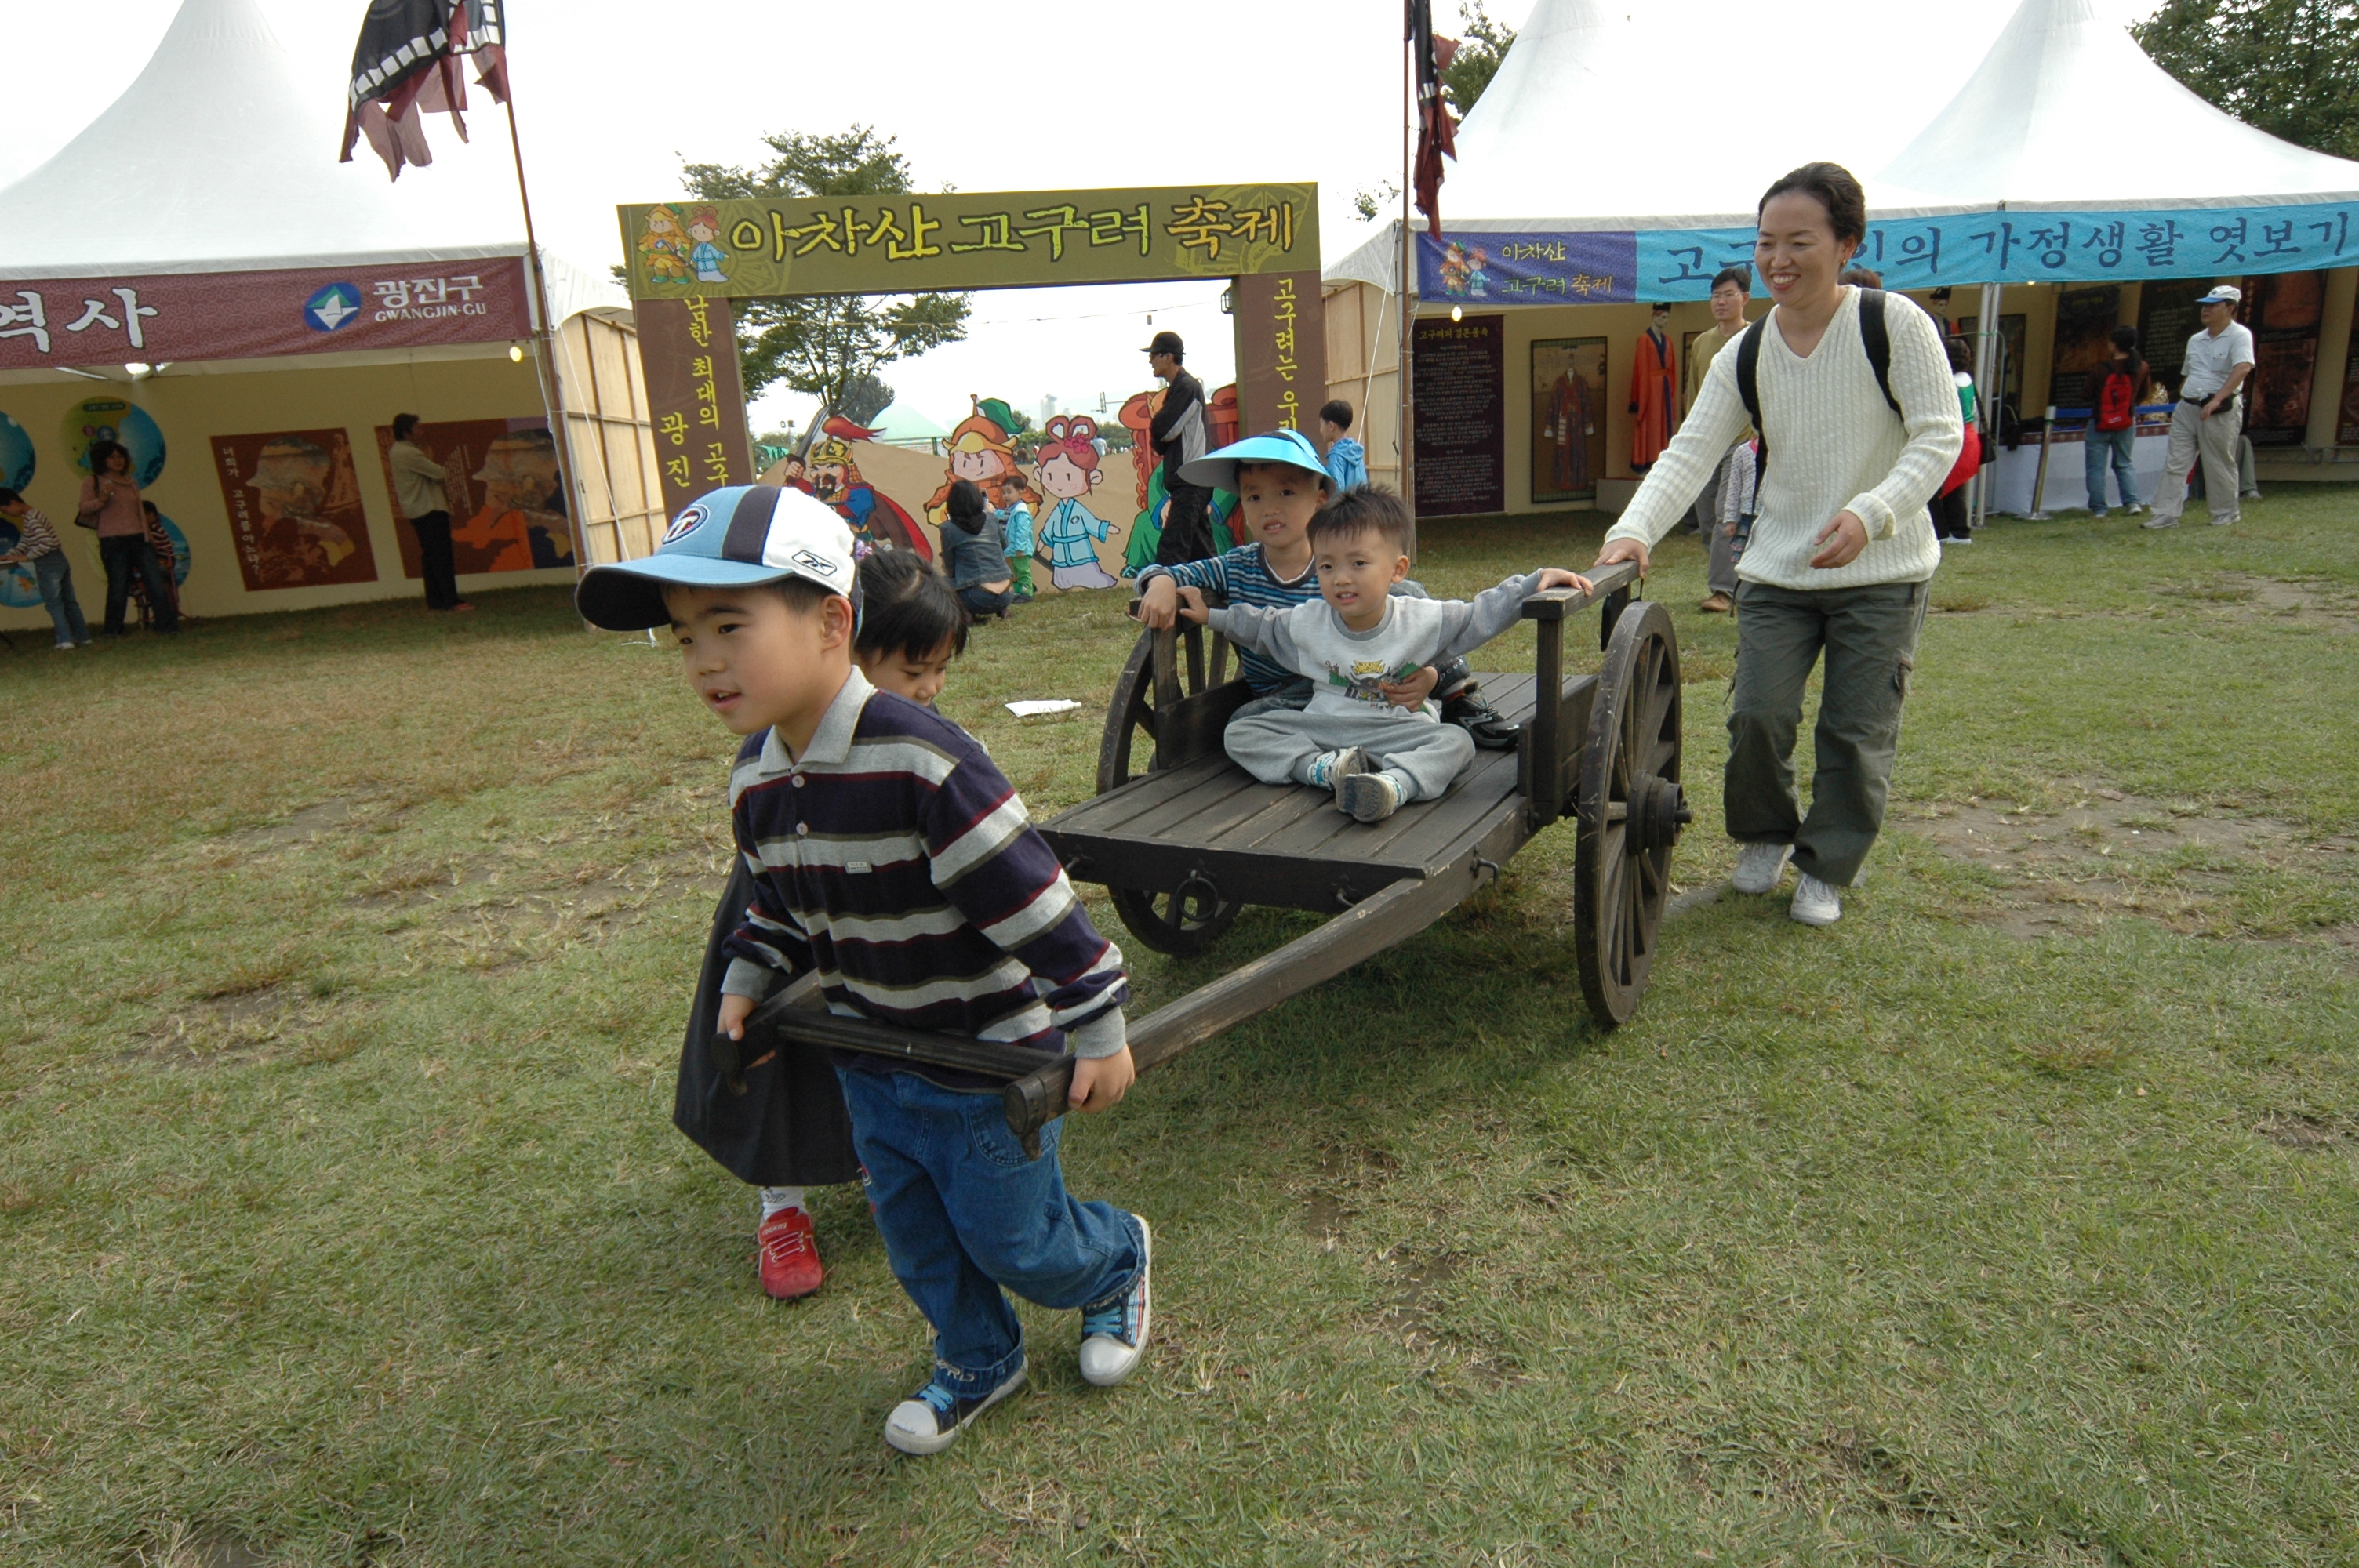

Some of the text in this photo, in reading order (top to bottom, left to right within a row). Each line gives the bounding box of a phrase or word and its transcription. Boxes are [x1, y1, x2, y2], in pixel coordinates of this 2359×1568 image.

[732, 194, 1295, 263] 아차산 고구려 축제
[1501, 241, 1567, 262] 아차산
[1658, 211, 2351, 285] 고구인의 가정생활 엿보기
[373, 275, 484, 309] 광진구
[374, 303, 487, 322] GWANGJIN-GU
[1501, 274, 1613, 296] 고구려 축제
[0, 287, 158, 354] 역사
[684, 293, 713, 347] 남한
[1273, 278, 1298, 382] 고구려는
[692, 355, 719, 431] 최대의
